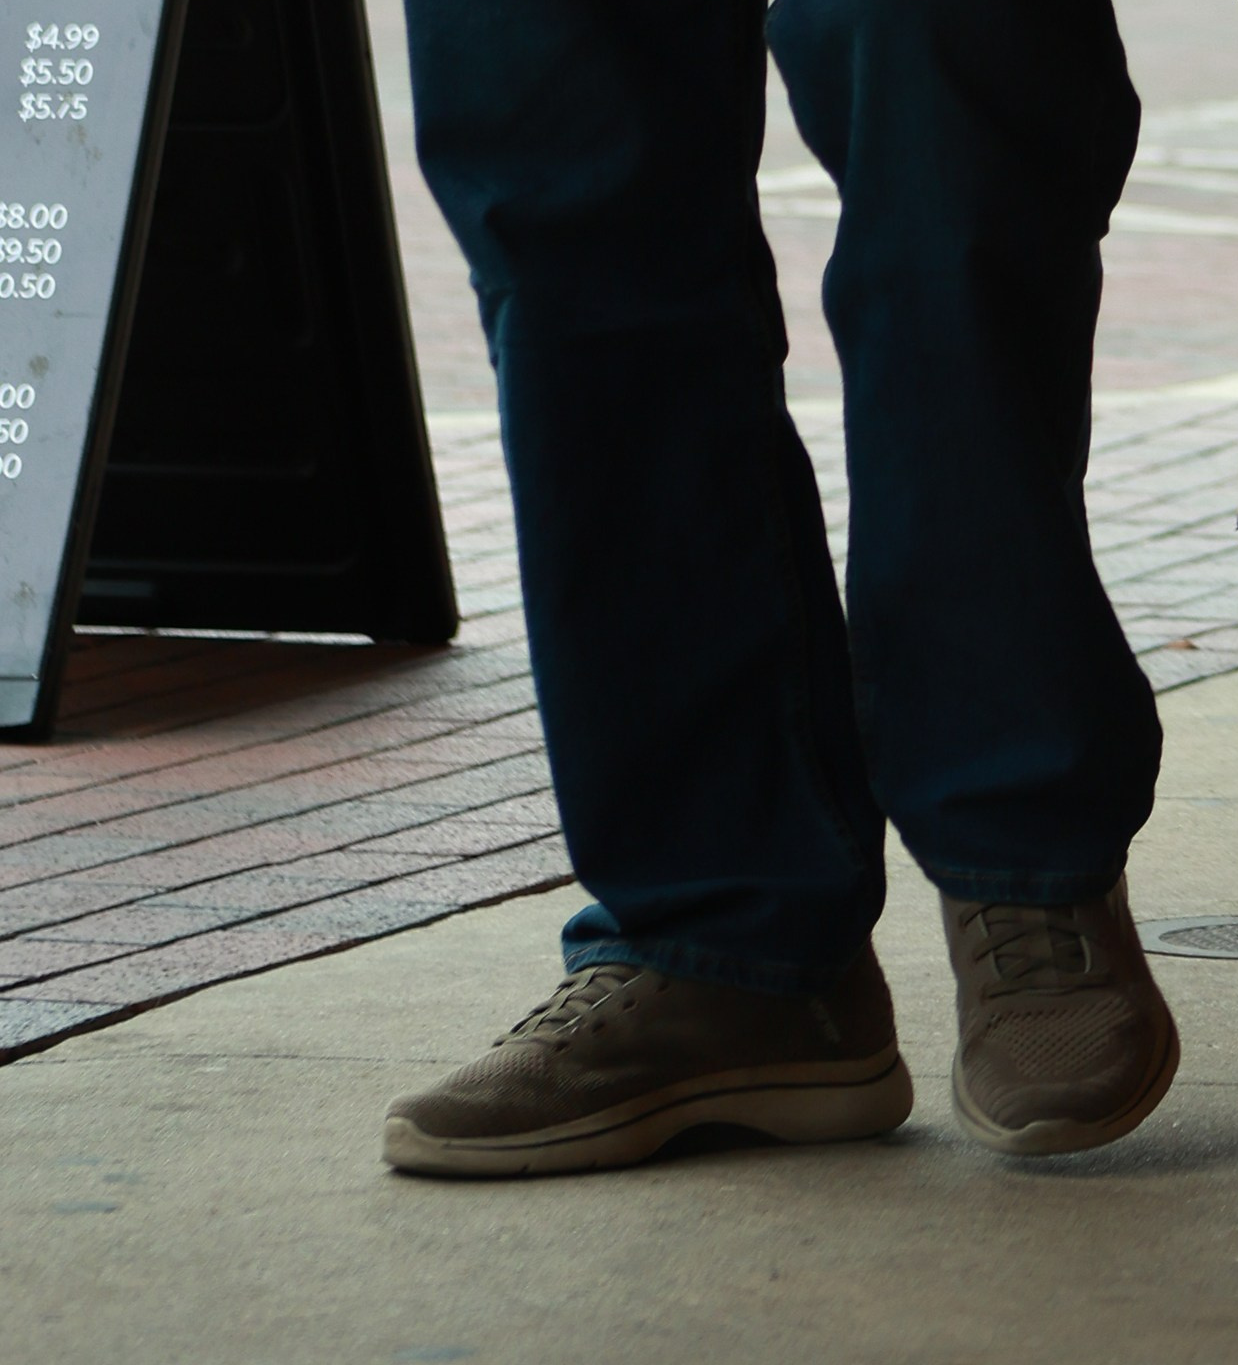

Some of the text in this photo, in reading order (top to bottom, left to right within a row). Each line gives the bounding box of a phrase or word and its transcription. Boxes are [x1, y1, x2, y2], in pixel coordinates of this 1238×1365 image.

[25, 21, 99, 53] $4.99
[19, 56, 94, 88] $5.50
[18, 92, 88, 122] $5.75
